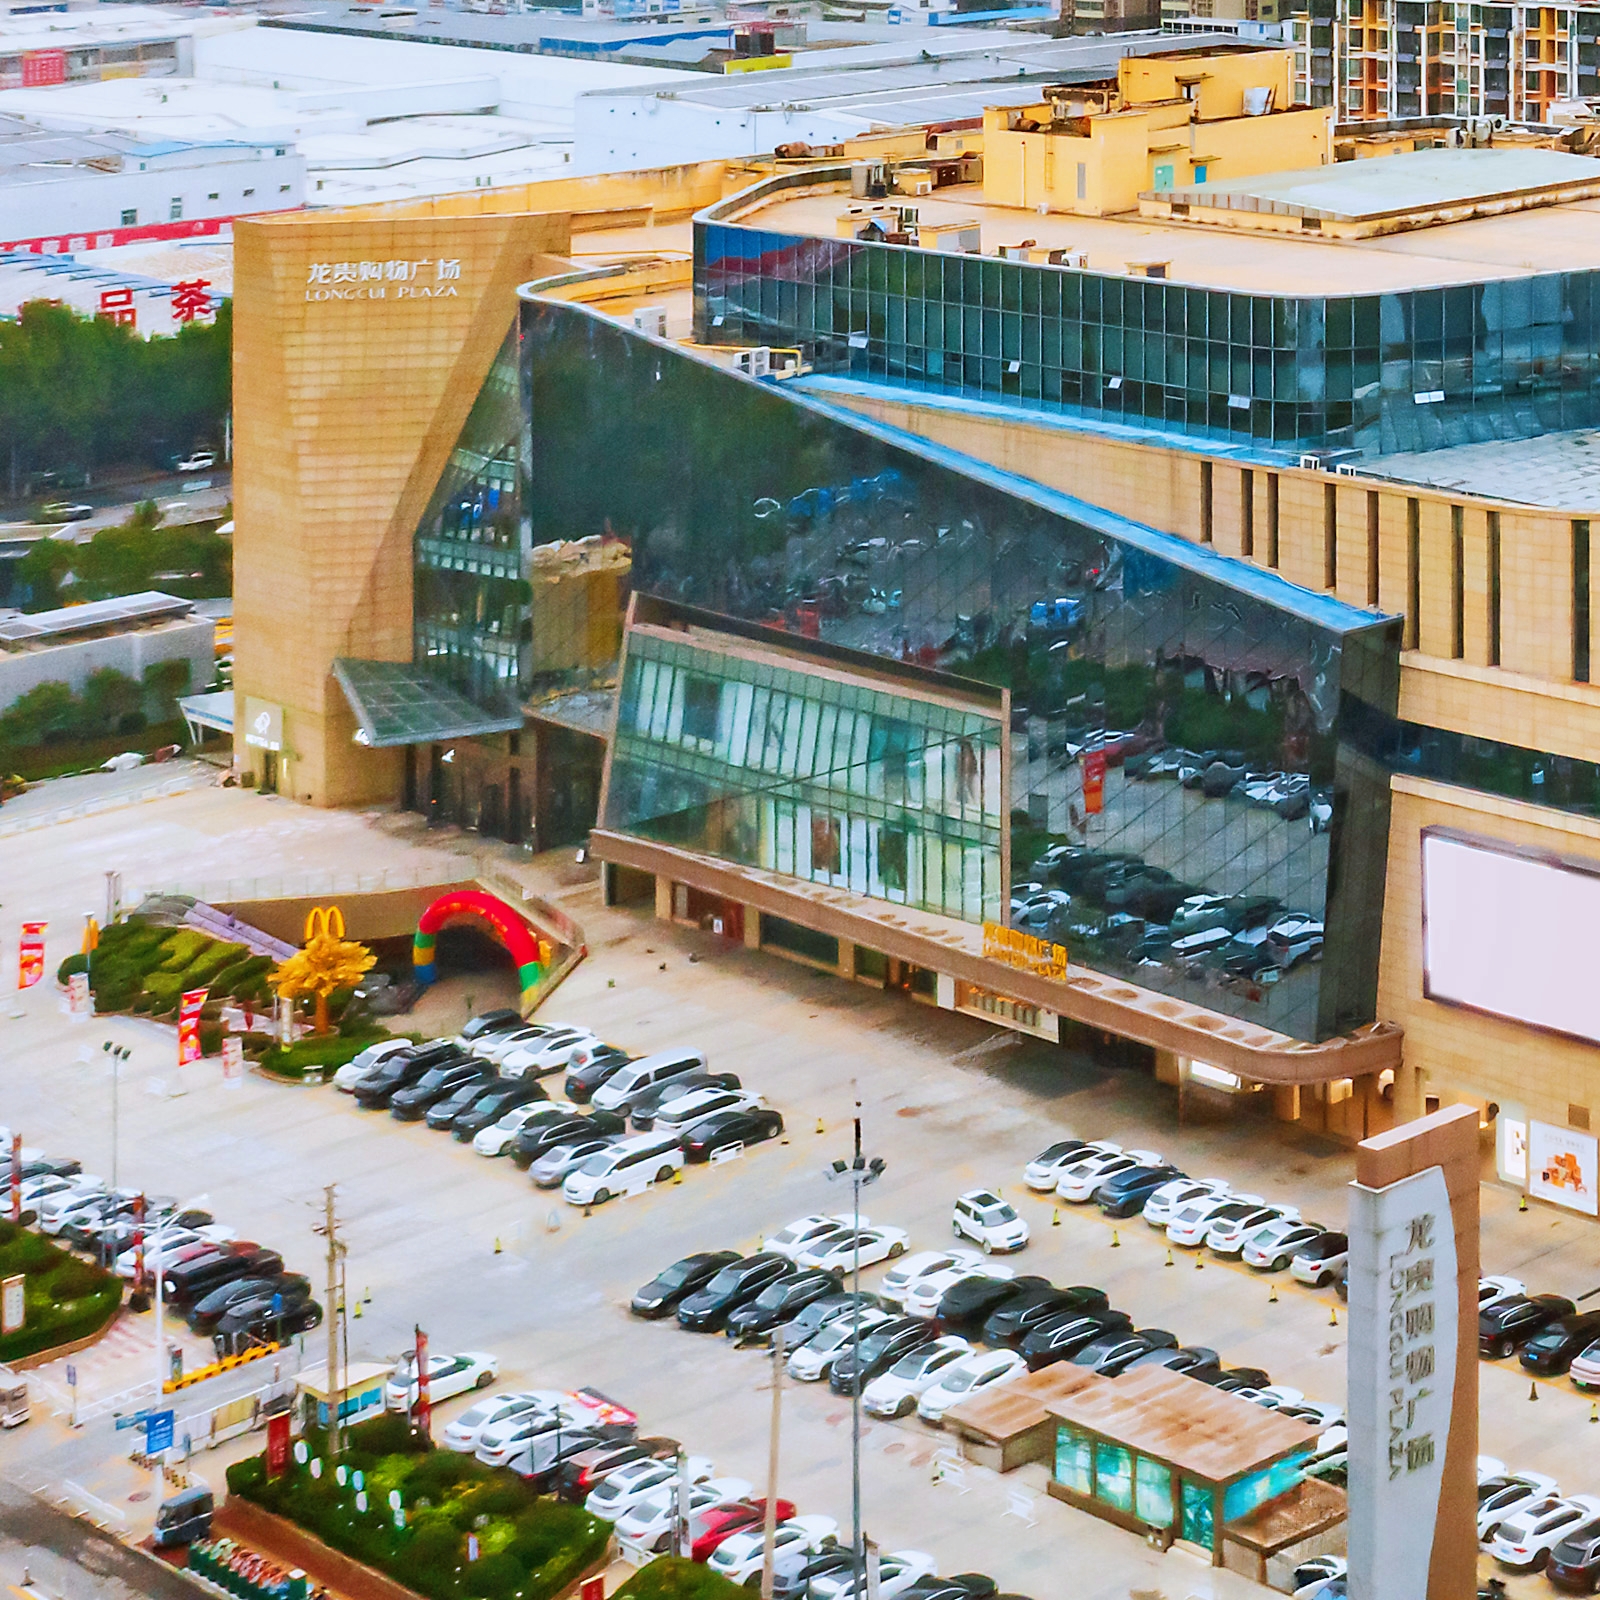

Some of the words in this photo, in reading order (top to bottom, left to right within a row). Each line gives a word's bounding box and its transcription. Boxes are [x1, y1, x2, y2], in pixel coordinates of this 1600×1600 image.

[307, 258, 461, 284] 龙贵购物广场
[397, 286, 458, 299] PLAZA
[1405, 1213, 1436, 1474] 龙贵购物广场
[1388, 1386, 1404, 1481] PLAZA
